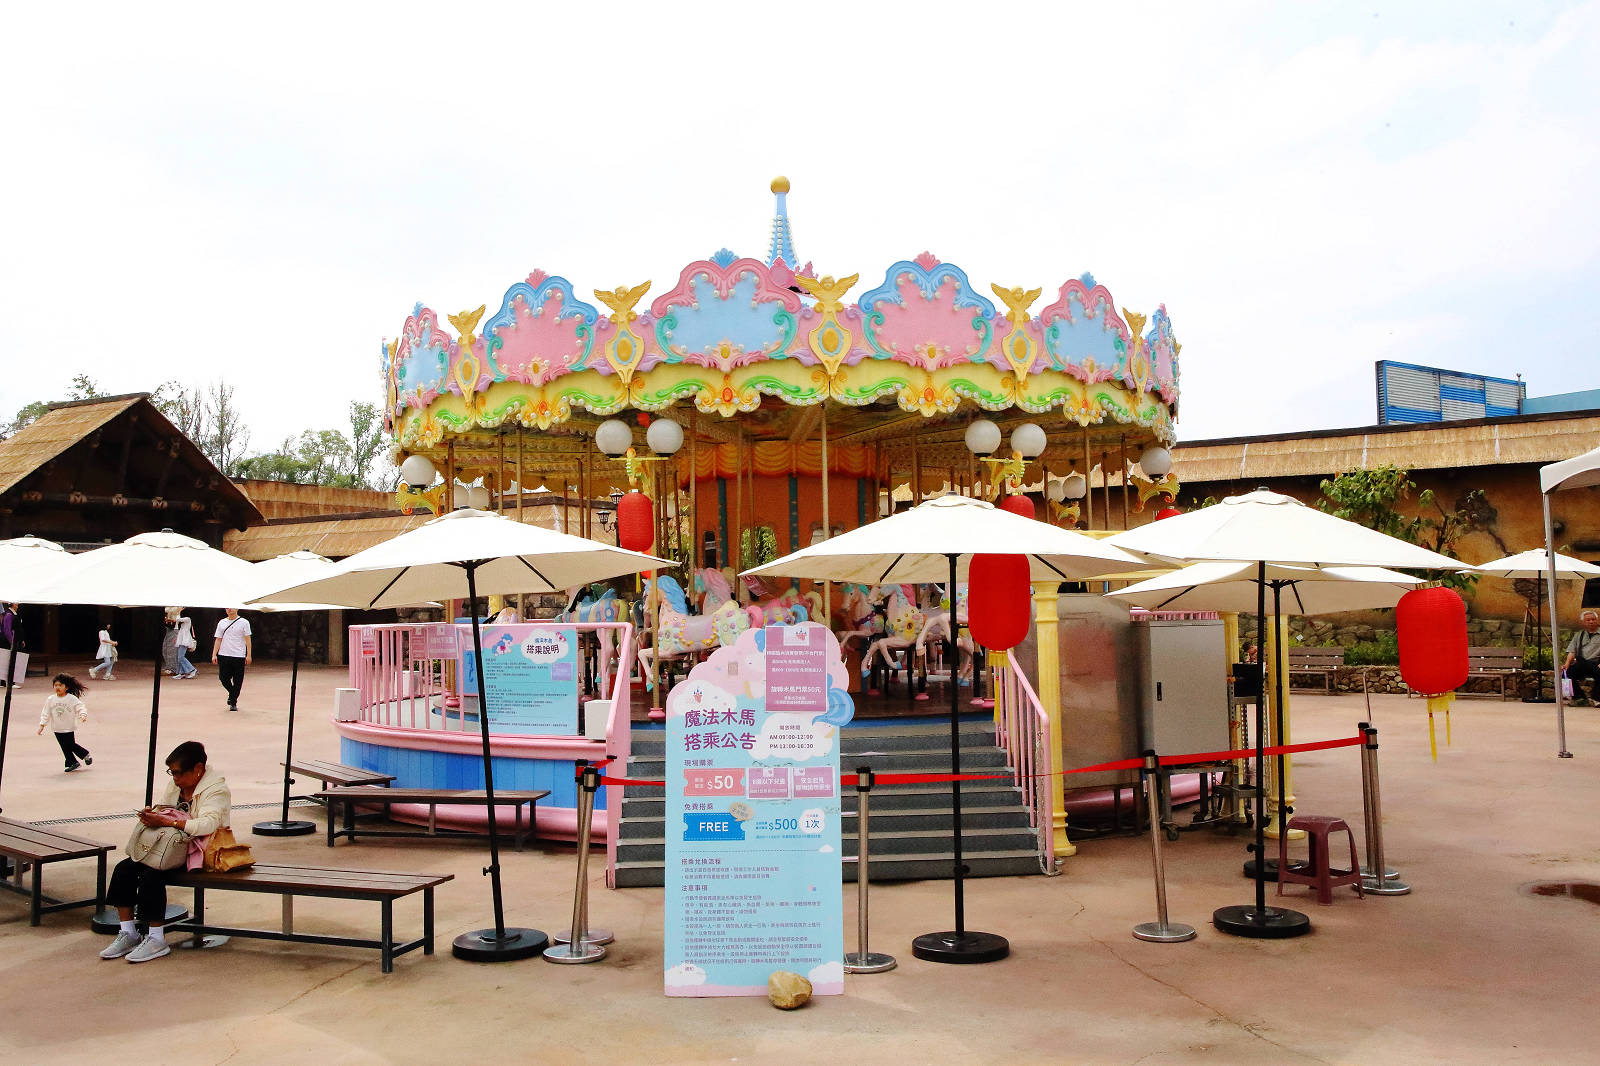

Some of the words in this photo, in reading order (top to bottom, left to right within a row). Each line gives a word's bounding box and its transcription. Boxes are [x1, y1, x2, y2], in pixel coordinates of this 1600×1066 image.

[526, 644, 560, 655] 搭乘說明
[684, 709, 756, 728] 魔法木馬
[684, 732, 756, 751] 搭乘公告
[683, 759, 714, 767] 現場購票
[706, 775, 734, 790] $50
[699, 821, 729, 832] FREE
[768, 818, 798, 831] $500
[805, 819, 820, 829] 1次
